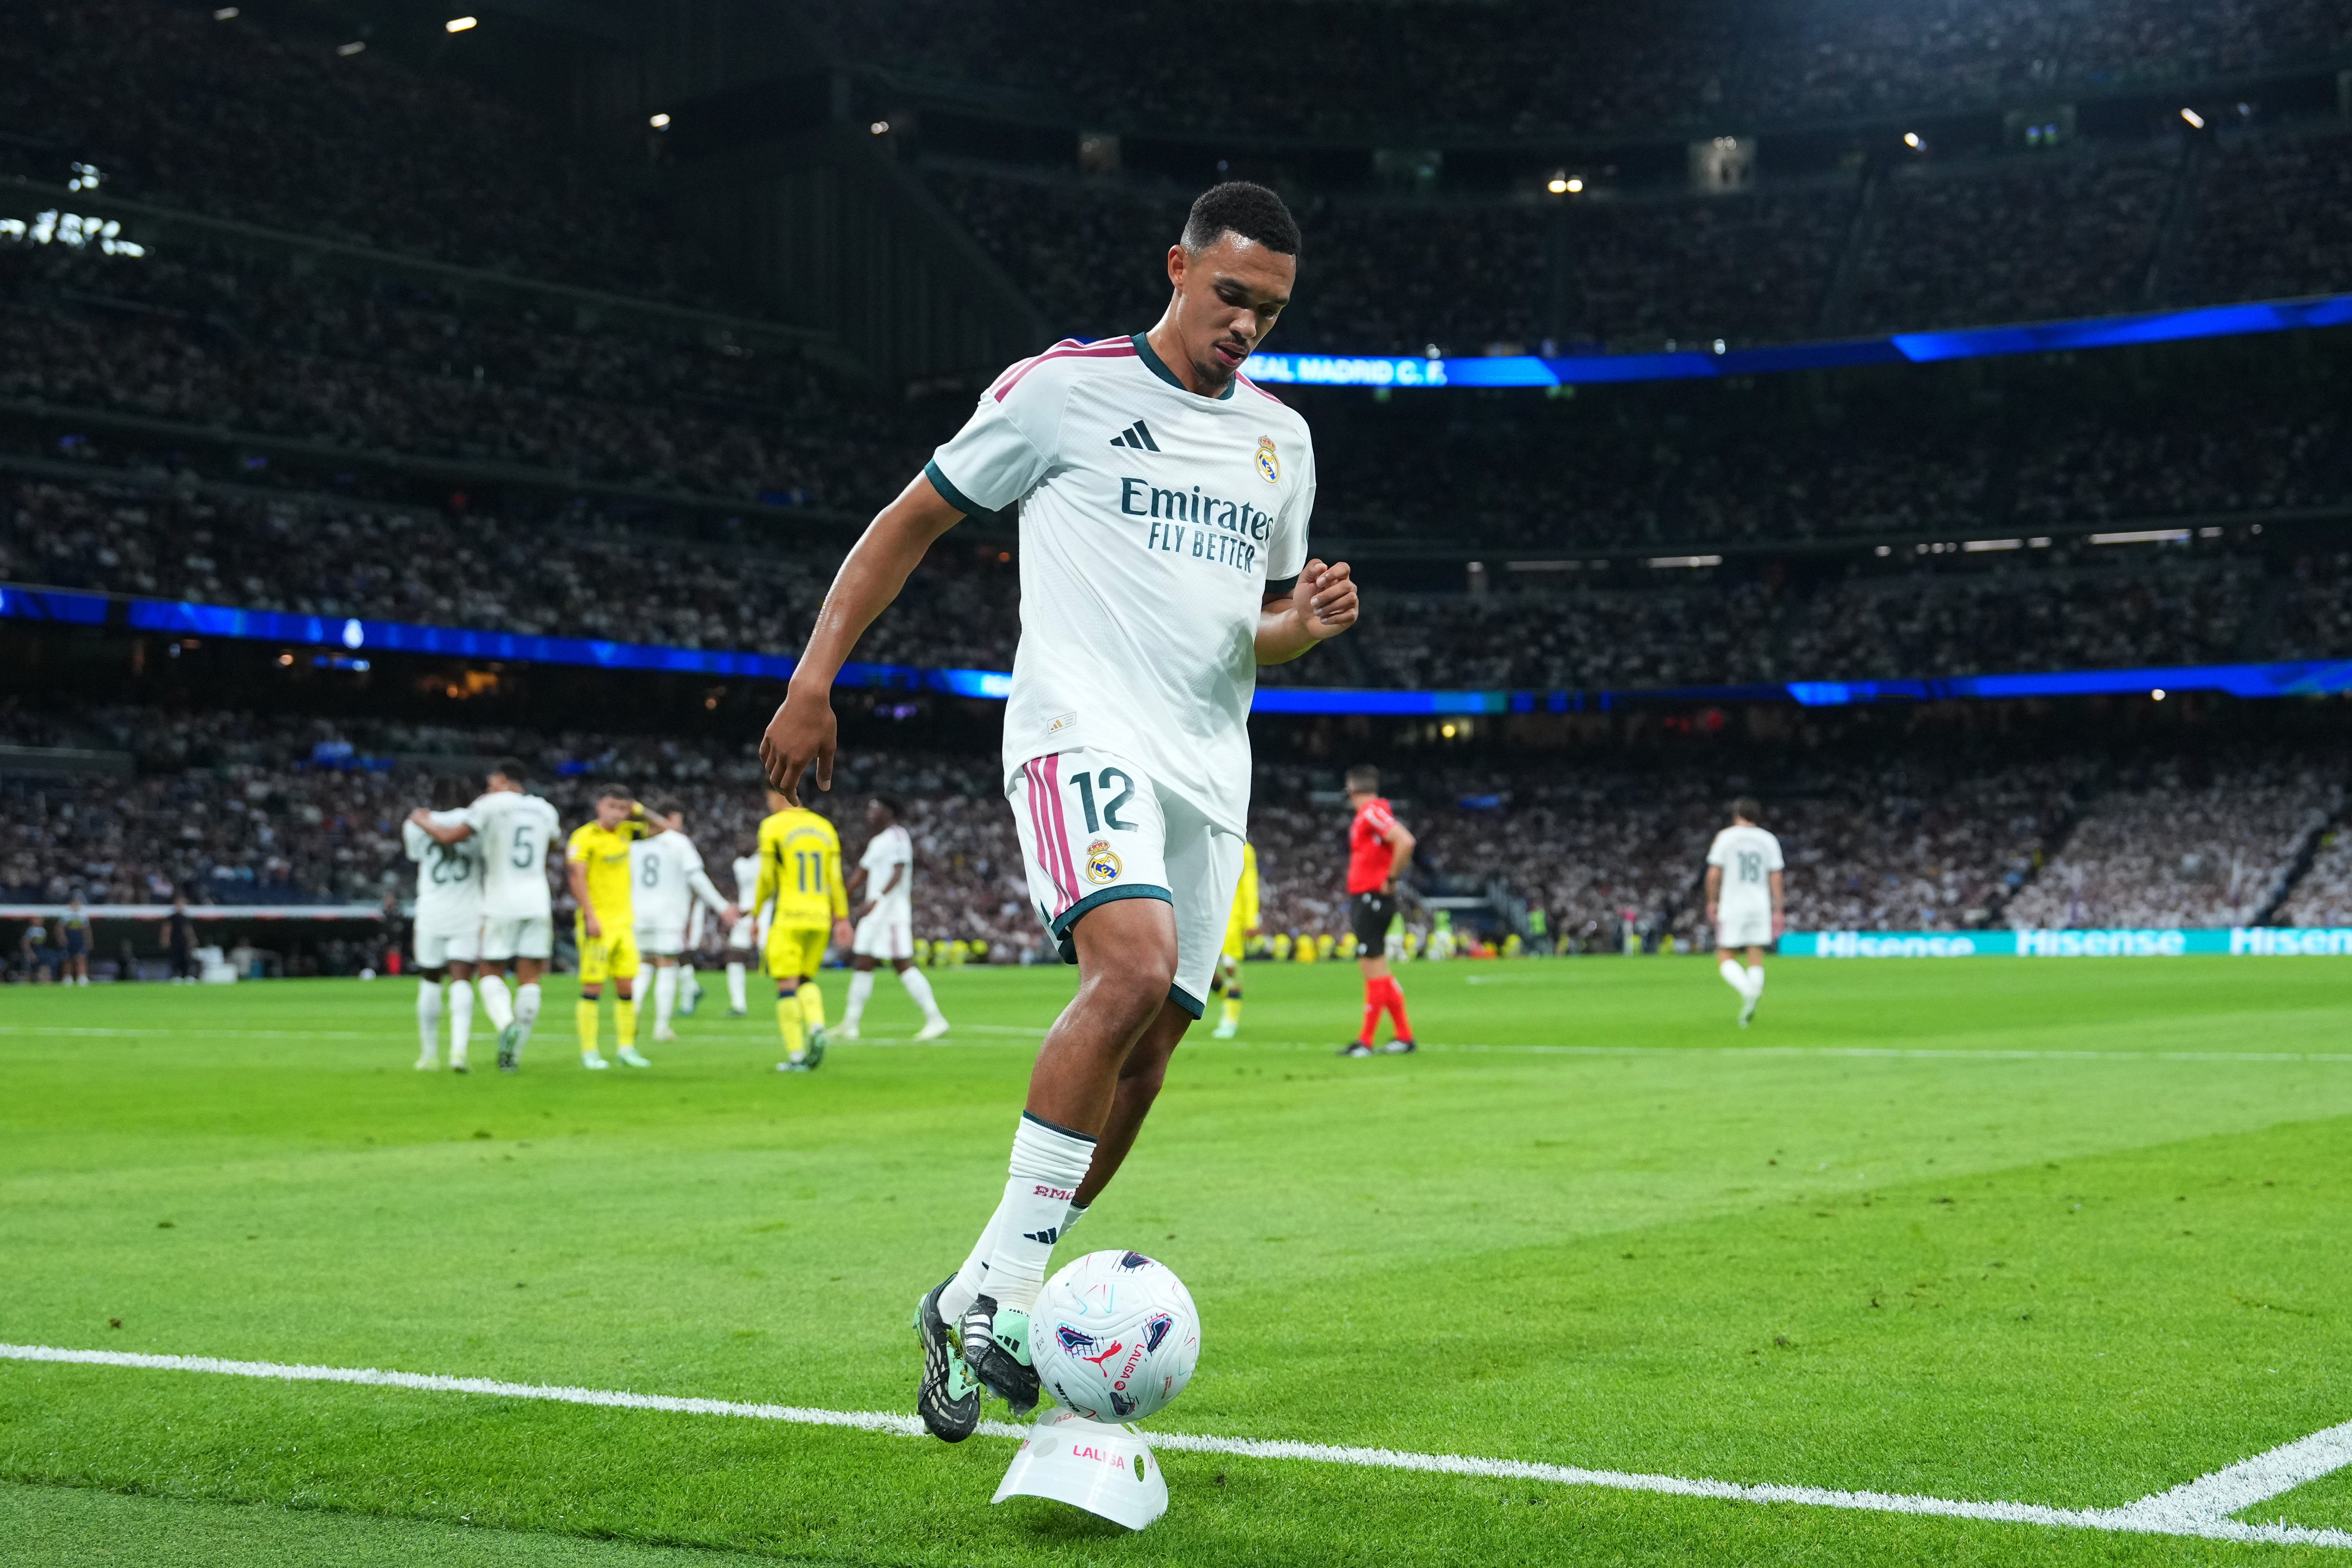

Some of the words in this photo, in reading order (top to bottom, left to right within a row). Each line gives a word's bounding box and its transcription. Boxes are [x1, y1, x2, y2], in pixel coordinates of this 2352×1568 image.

[1297, 357, 1394, 385] MADRID
[1148, 522, 1185, 552] FLY
[1192, 530, 1255, 574] BETTER
[1069, 766, 1139, 834] 12
[511, 826, 534, 868] 5
[641, 854, 660, 888] 8
[794, 851, 822, 893] 11
[1816, 931, 1975, 958] Hisense
[2016, 928, 2186, 956] Hisense
[1120, 1344, 1145, 1379] LALIGA
[1054, 1380, 1080, 1413] NITRO
